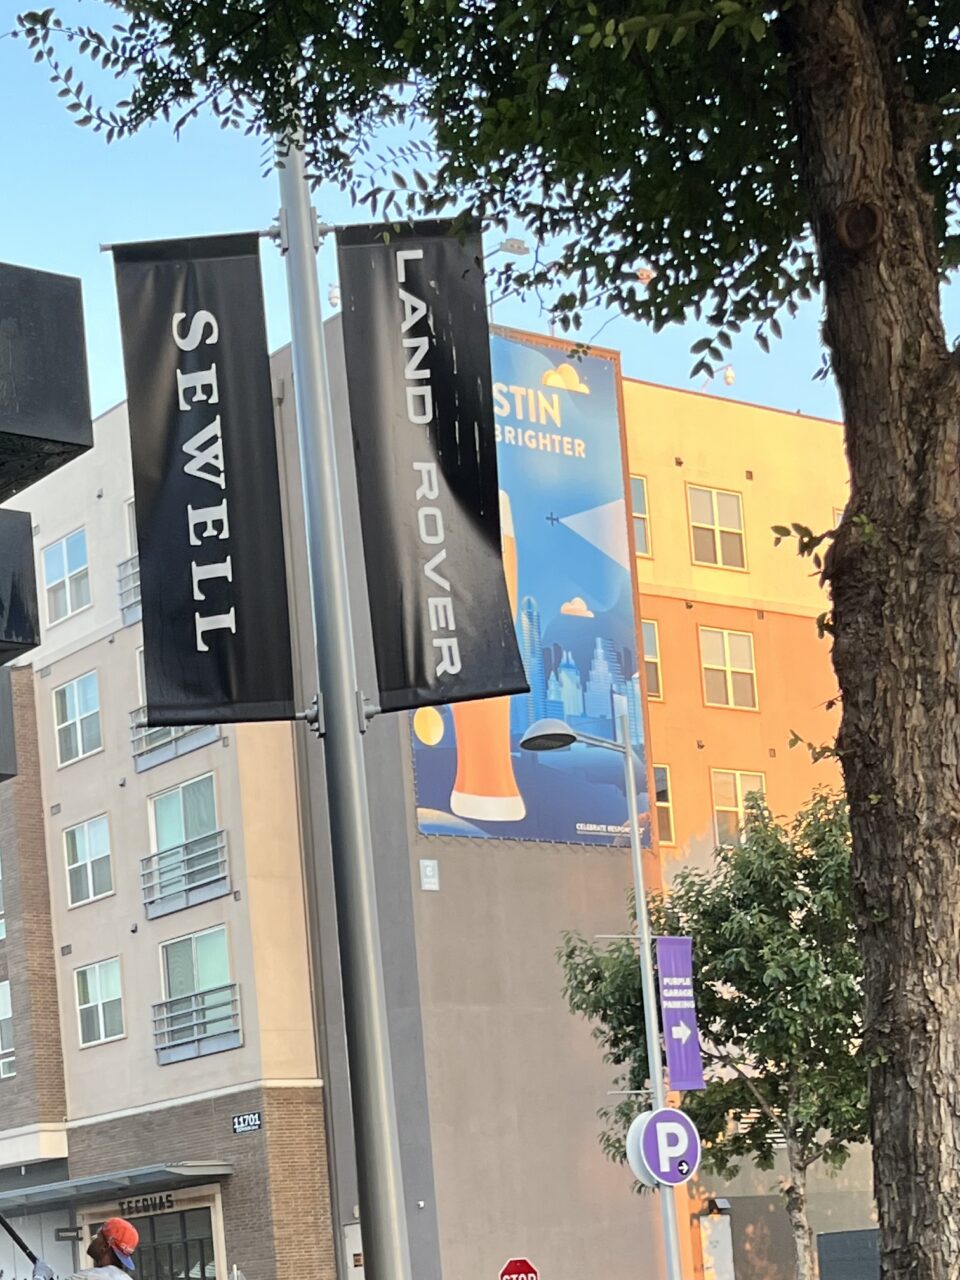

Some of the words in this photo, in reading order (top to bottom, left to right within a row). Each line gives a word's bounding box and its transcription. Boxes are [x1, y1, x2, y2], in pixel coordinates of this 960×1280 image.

[396, 249, 434, 425] LAND
[494, 424, 586, 458] BRIGHTER
[172, 310, 236, 652] SEWELL
[412, 461, 462, 677] ROVER
[663, 977, 691, 986] PURPLE
[663, 988, 694, 997] GARAGE
[663, 1000, 696, 1009] PARKING
[233, 1113, 260, 1129] 11701
[656, 1122, 689, 1172] P
[119, 1194, 174, 1215] TECOVAS
